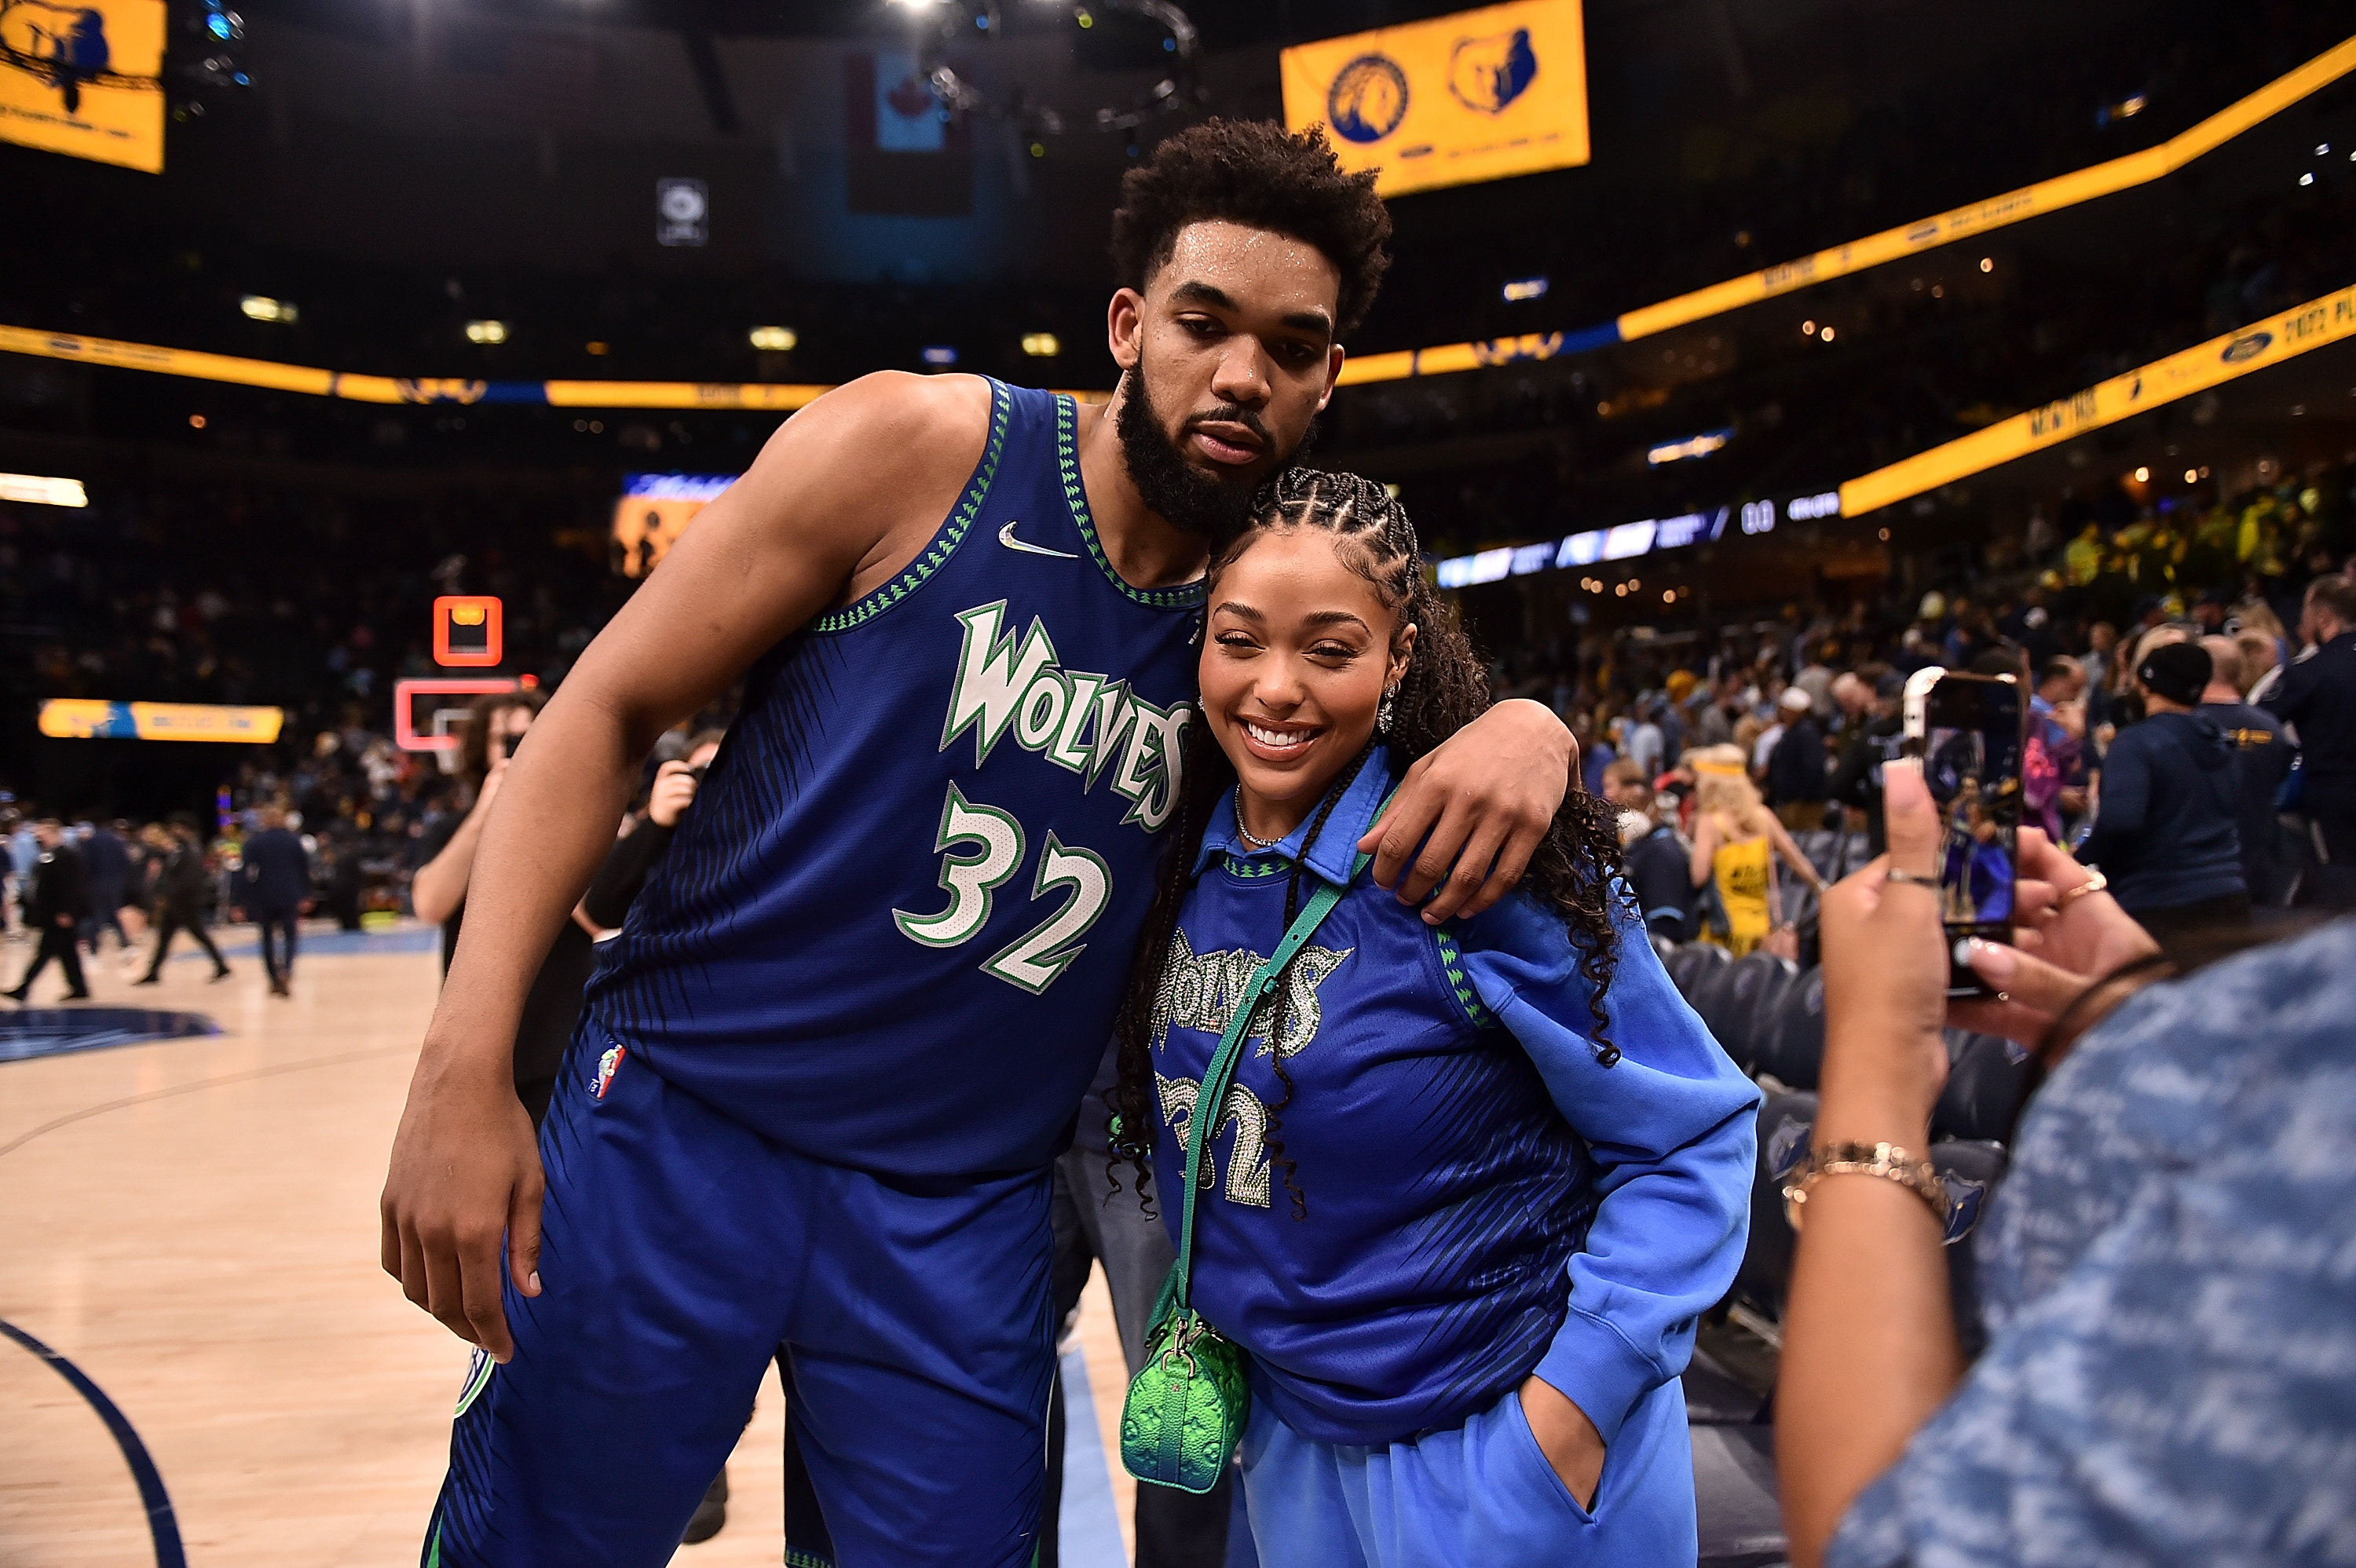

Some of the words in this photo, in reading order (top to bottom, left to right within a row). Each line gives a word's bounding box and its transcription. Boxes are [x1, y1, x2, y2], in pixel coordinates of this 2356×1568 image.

[938, 598, 1192, 834] WOLVES
[892, 780, 1113, 996] 32
[1154, 1071, 1271, 1208] 32
